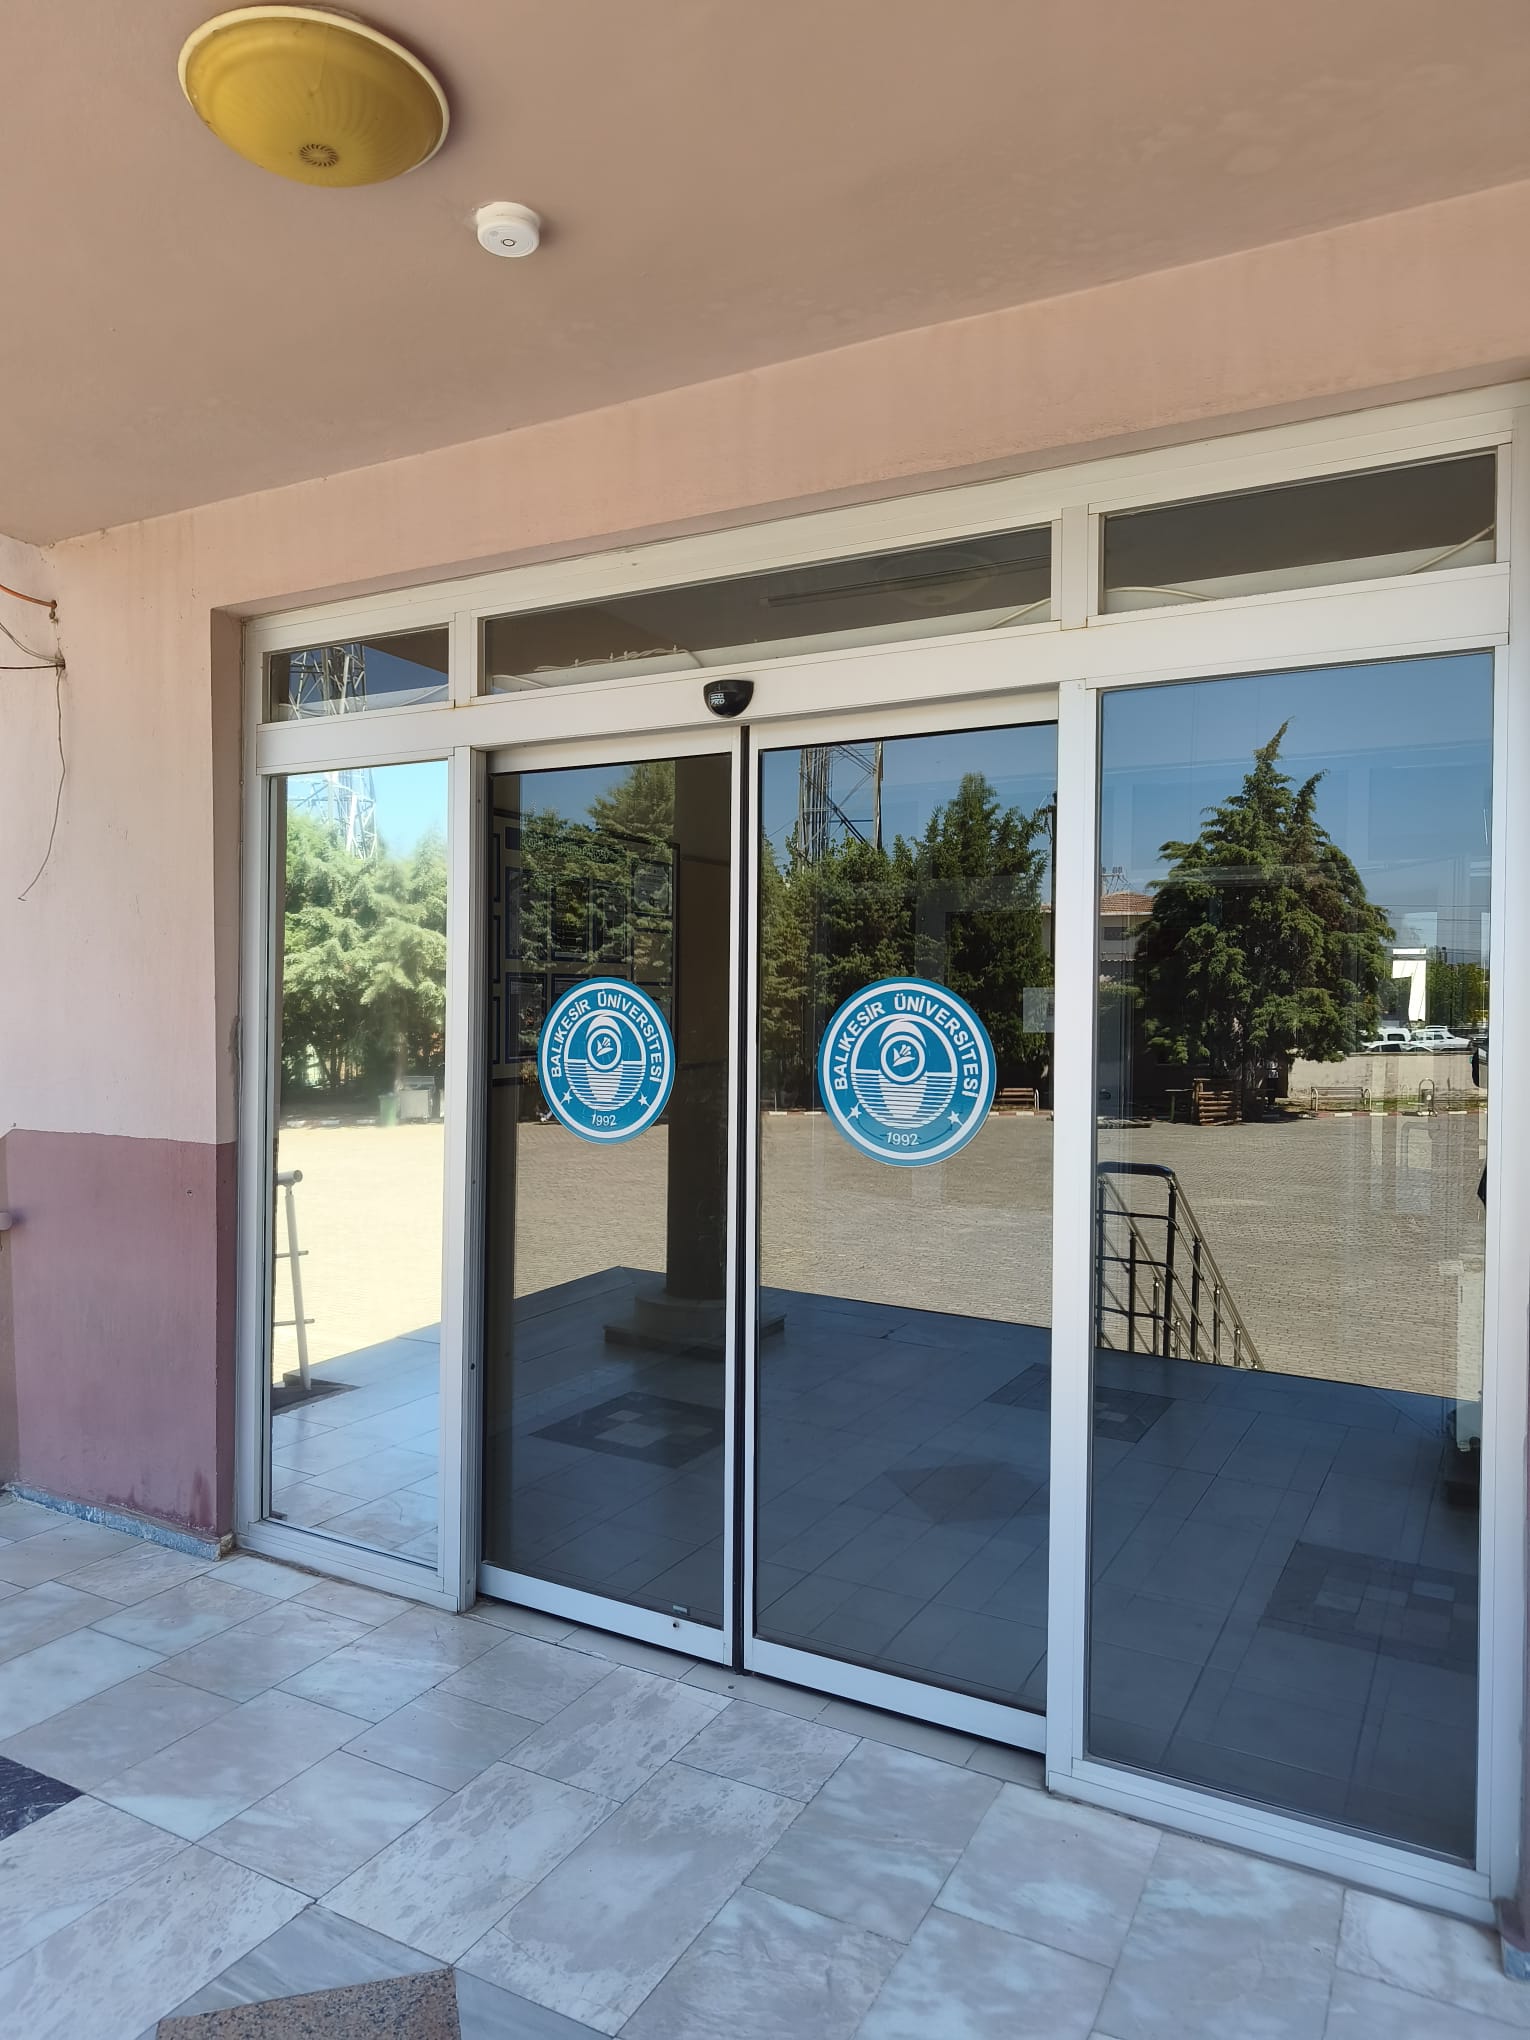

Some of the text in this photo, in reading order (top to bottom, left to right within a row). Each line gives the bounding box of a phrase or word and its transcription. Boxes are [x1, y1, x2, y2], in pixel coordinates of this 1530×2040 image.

[551, 989, 662, 1083] BALIKESİR ÜNİVERSİTESİ
[834, 993, 979, 1098] BALIKESİR ÜNİVERSİTESİ
[591, 1113, 617, 1126] 1992
[887, 1132, 919, 1146] 1992
